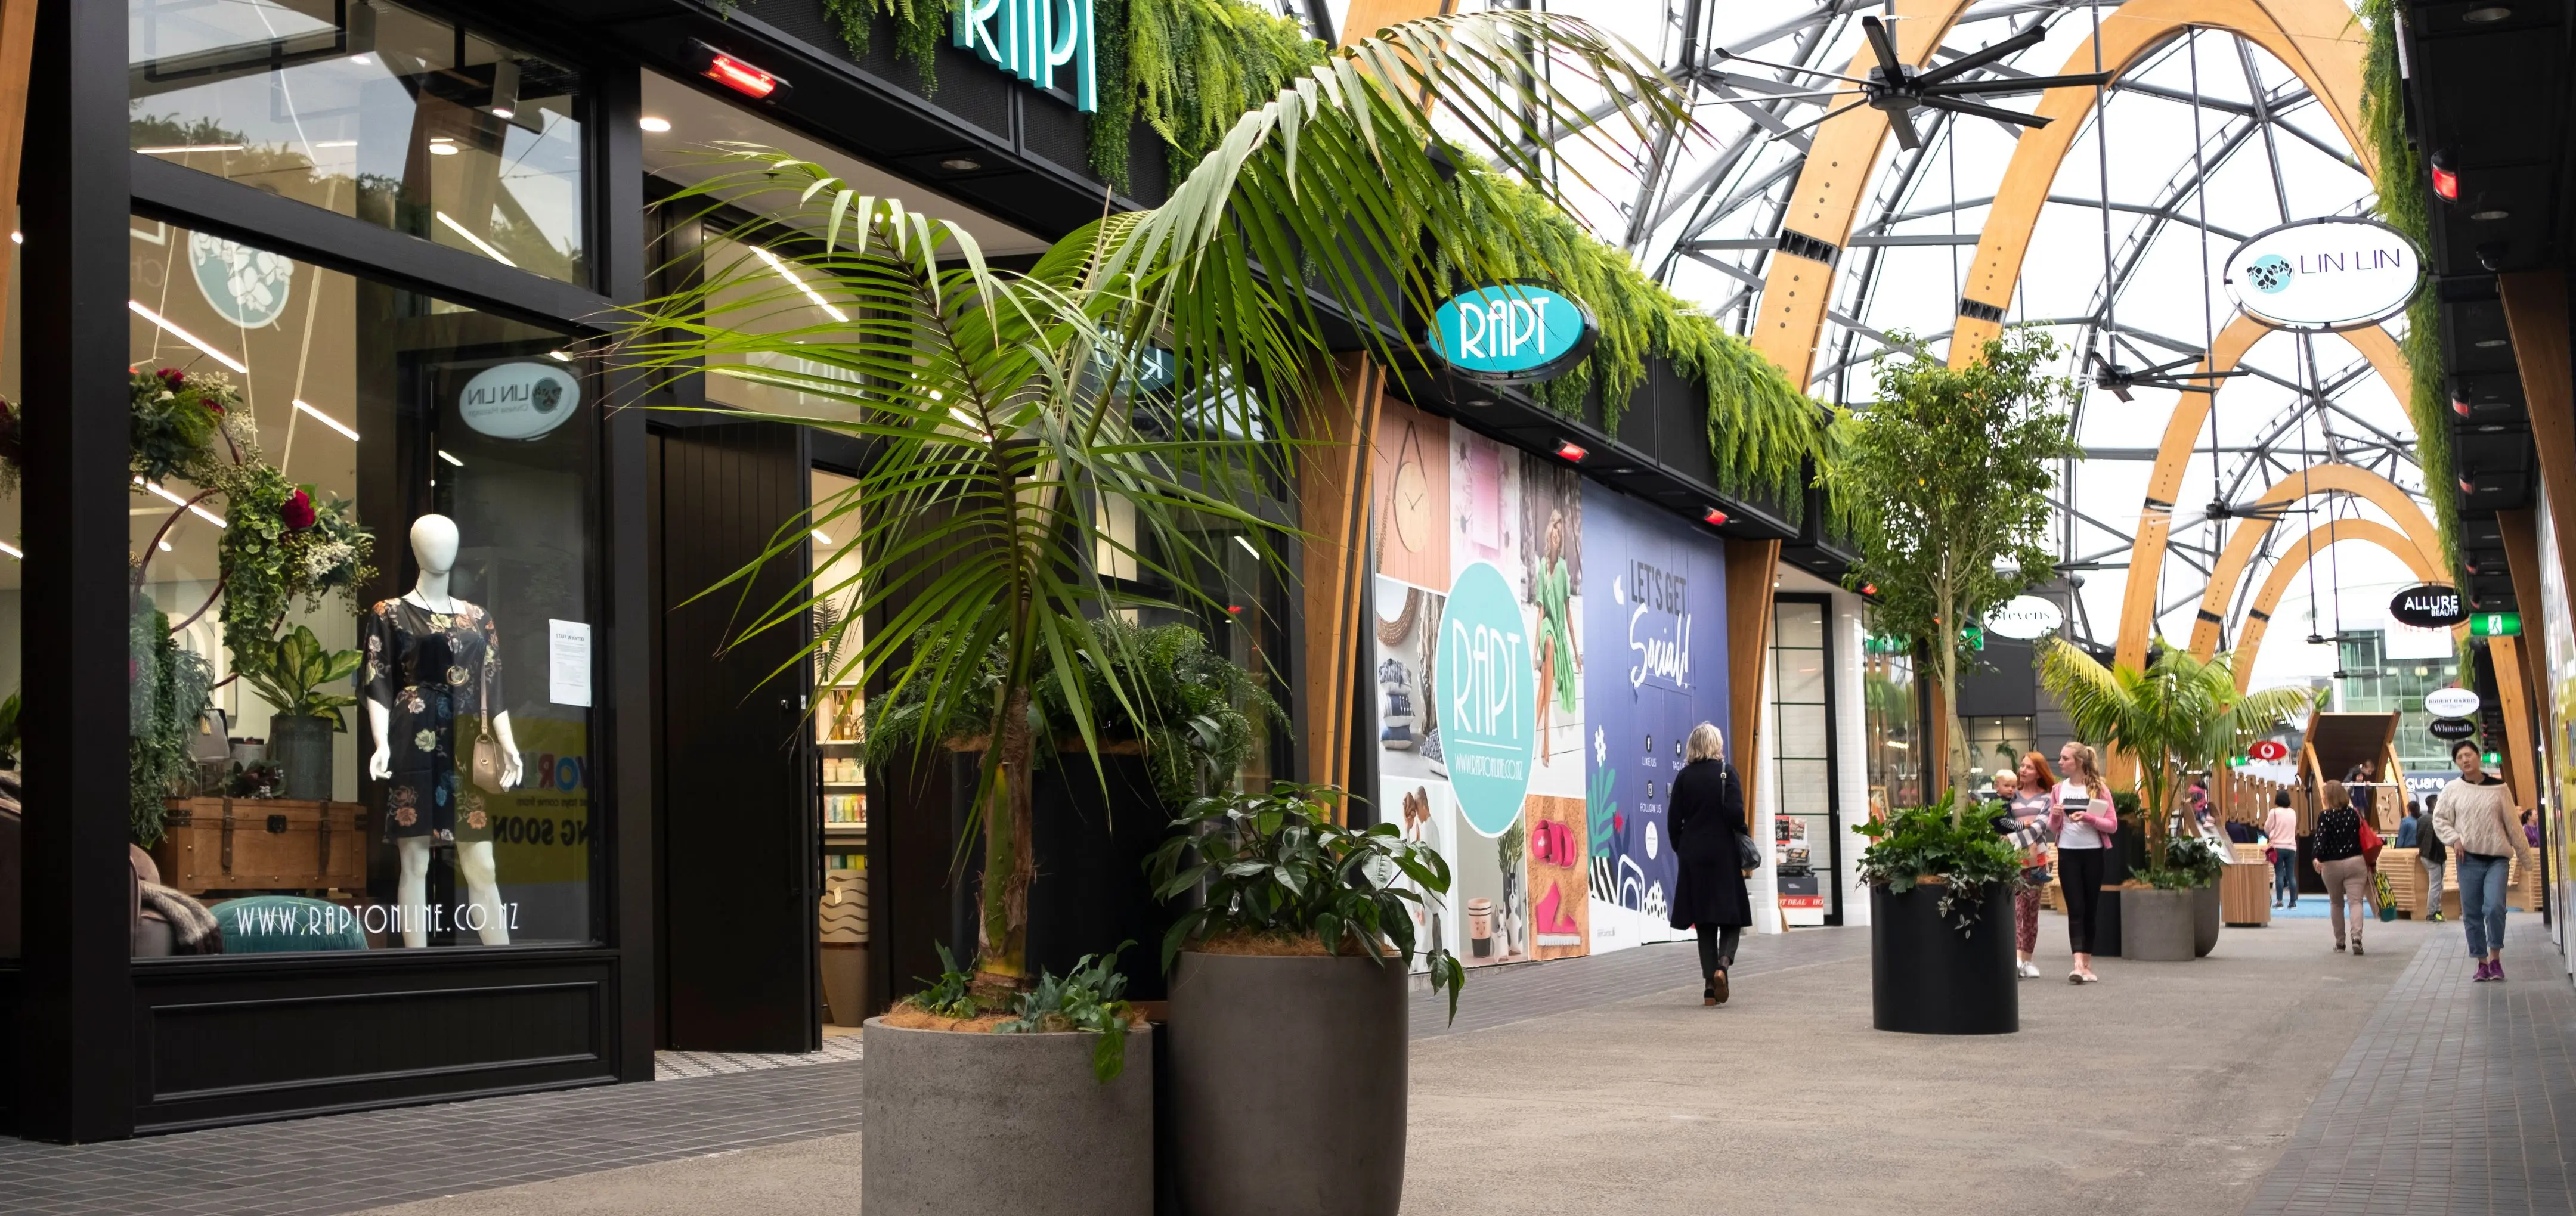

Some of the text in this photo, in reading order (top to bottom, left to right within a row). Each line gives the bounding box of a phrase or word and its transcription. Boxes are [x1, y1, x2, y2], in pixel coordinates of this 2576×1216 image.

[2301, 248, 2400, 274] LIN LIN
[1460, 297, 1549, 359] RAPT
[1630, 559, 1686, 618] LET'S GET
[2404, 595, 2458, 610] ALLURE
[2431, 608, 2458, 616] BEAUTY
[1452, 618, 1521, 739] RAPT
[1642, 756, 1657, 767] LIKE US
[2403, 777, 2445, 791] quare
[1640, 802, 1661, 813] FOLLOW US
[236, 902, 518, 936] WWW.RAPTONLINE.CO.NZ
